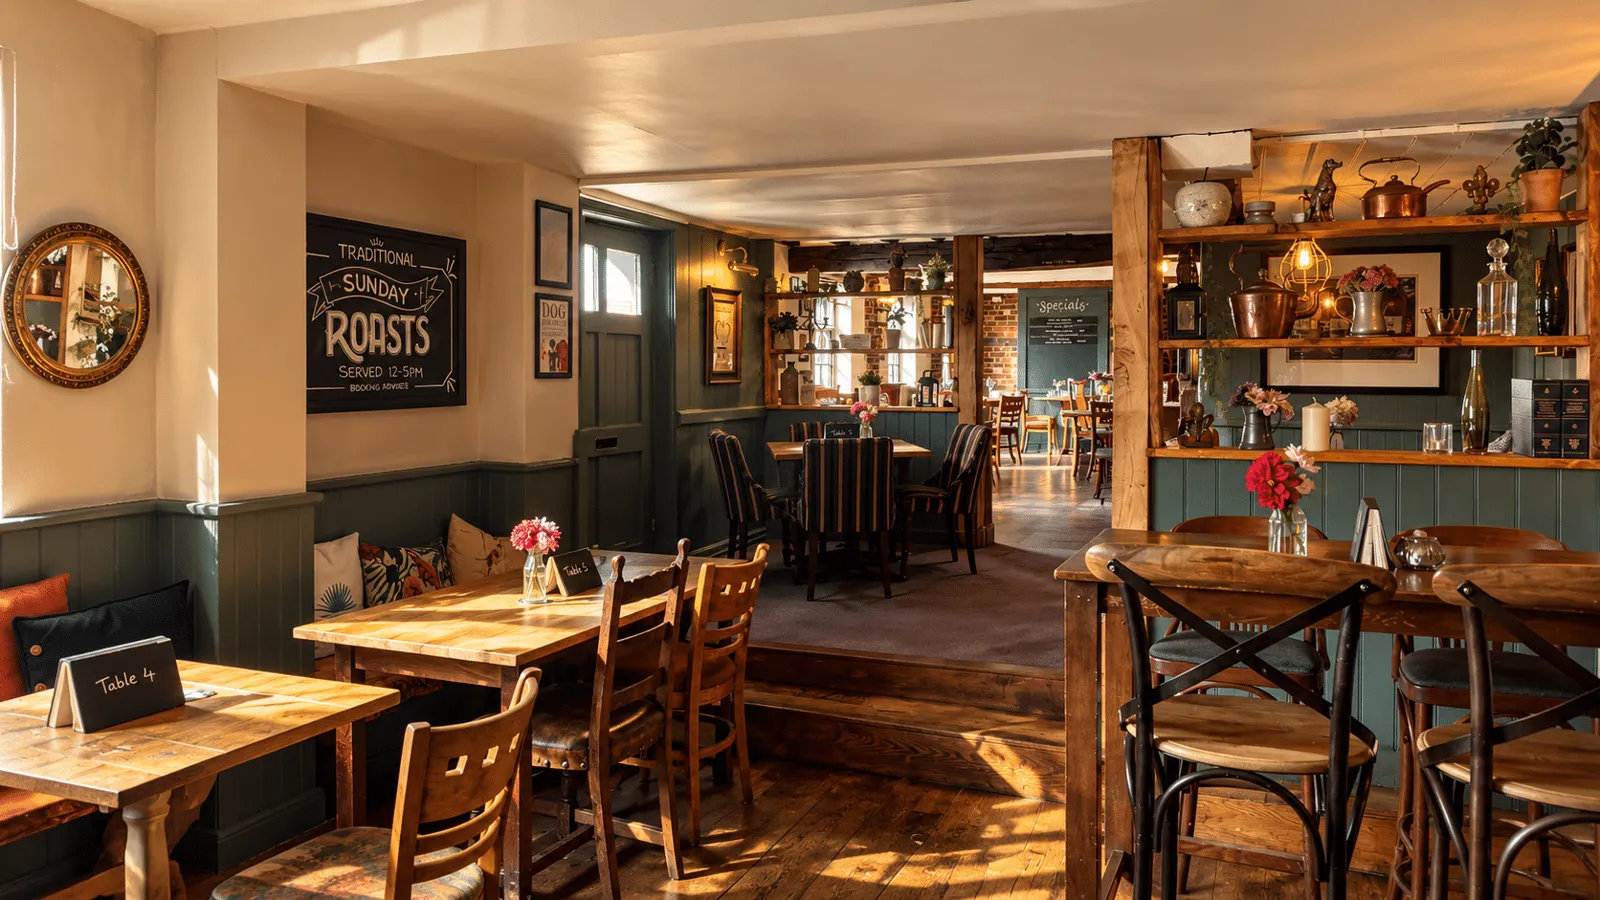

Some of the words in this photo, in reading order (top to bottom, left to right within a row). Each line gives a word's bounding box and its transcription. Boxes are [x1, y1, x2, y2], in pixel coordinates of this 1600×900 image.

[338, 243, 417, 268] TRADITIONAL
[343, 274, 410, 305] SUNDAY
[542, 302, 566, 319] DOG
[1040, 298, 1085, 313] Specials
[325, 310, 431, 363] ROASTS
[339, 365, 383, 379] SERVED
[389, 365, 423, 379] 12-5PM
[95, 672, 138, 694] Table
[143, 667, 156, 682] 4
